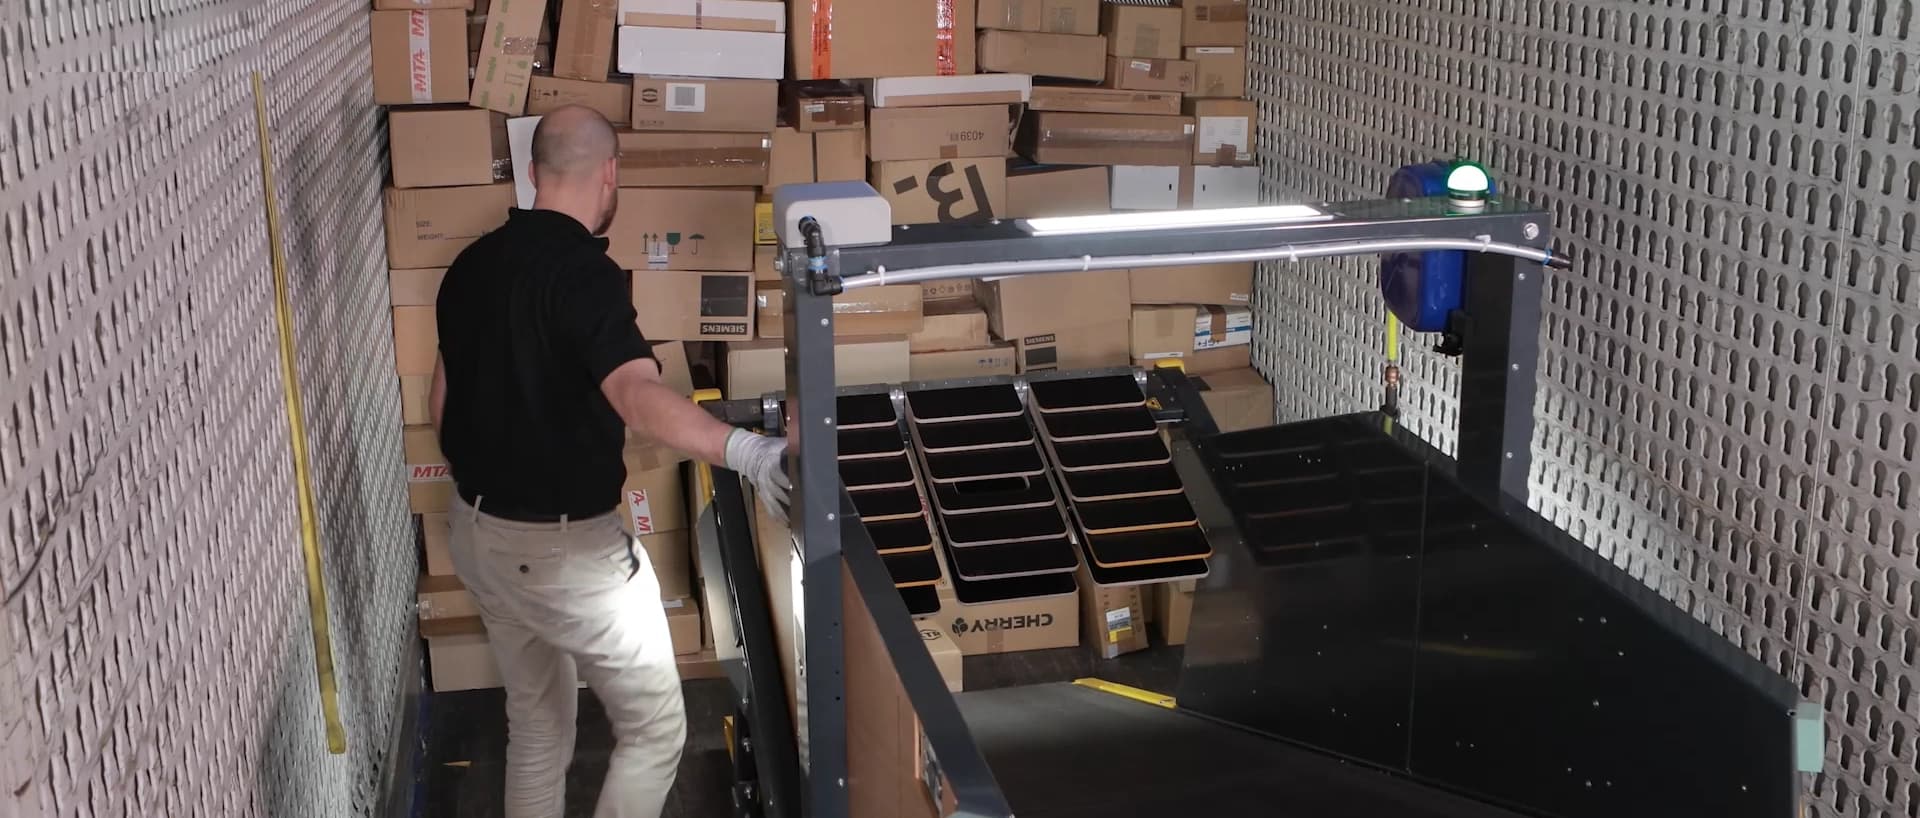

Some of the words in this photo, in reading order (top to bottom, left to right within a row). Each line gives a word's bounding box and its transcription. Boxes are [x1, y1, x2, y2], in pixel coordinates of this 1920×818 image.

[411, 8, 425, 37] MT
[412, 48, 427, 92] MTA
[702, 324, 745, 333] SIEMENS
[970, 613, 1053, 632] CHERRY
